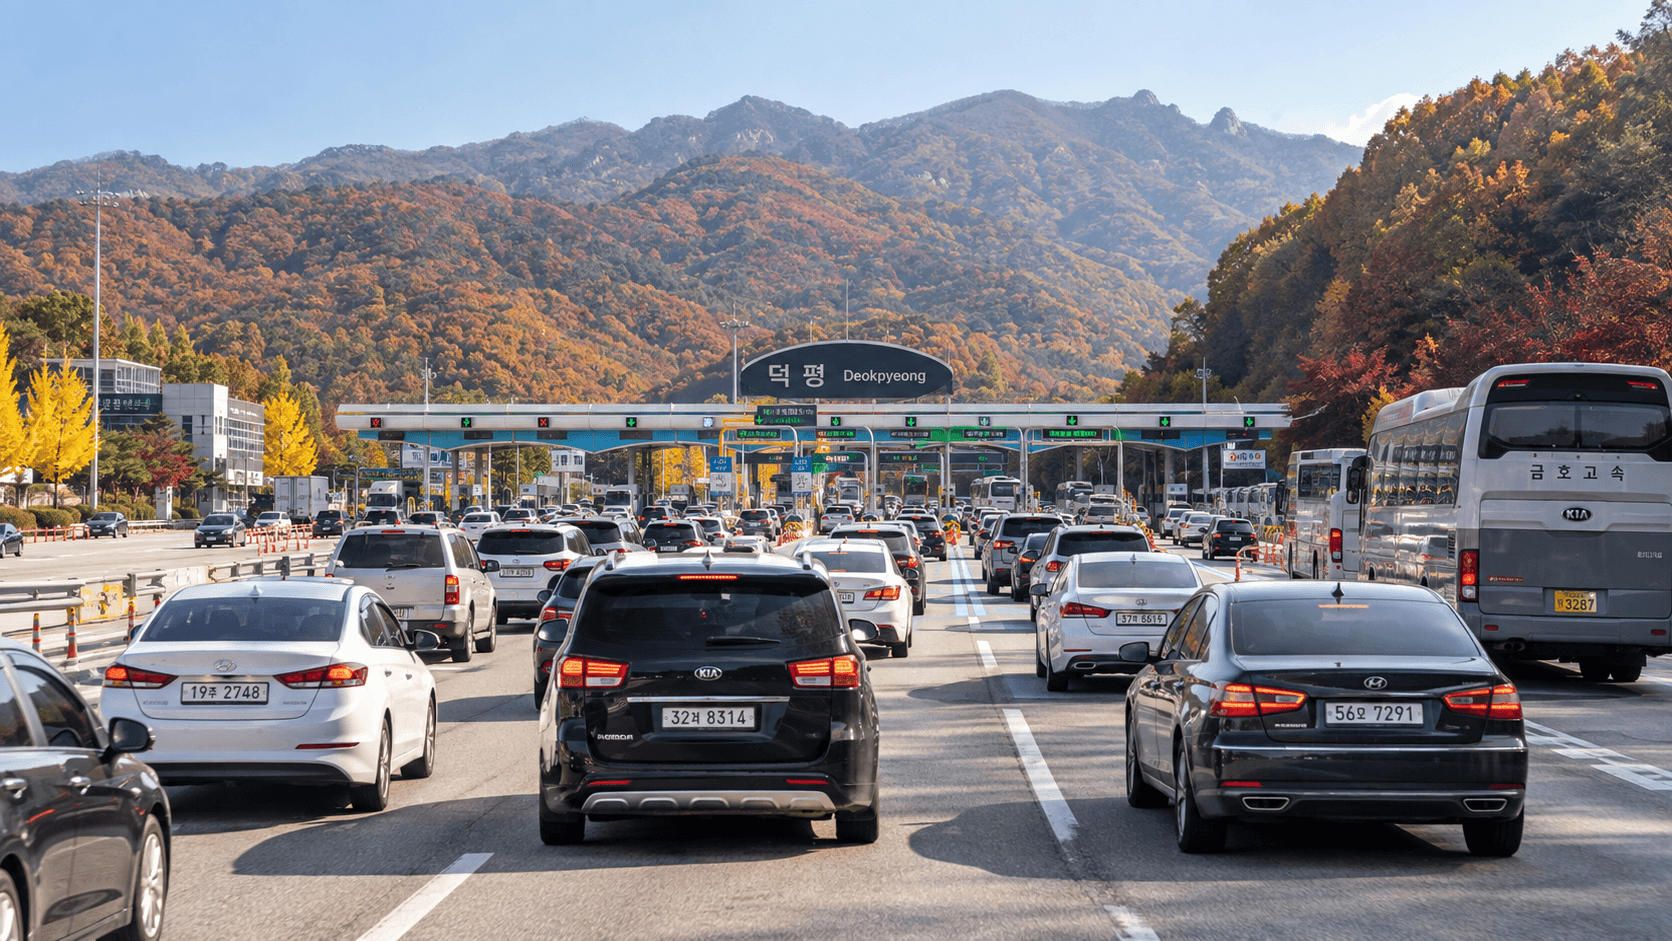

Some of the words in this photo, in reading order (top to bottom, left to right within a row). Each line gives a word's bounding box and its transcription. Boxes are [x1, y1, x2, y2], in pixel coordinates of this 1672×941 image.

[768, 363, 825, 388] 덕평
[843, 369, 927, 384] Deokpyeong
[1530, 464, 1624, 482] 금호고속
[1566, 509, 1589, 519] KIA
[1565, 598, 1595, 611] 3287
[699, 668, 718, 678] KIA
[190, 685, 217, 699] 19주
[223, 685, 260, 699] 2748
[706, 710, 746, 725] 8314
[1373, 705, 1413, 721] 7291
